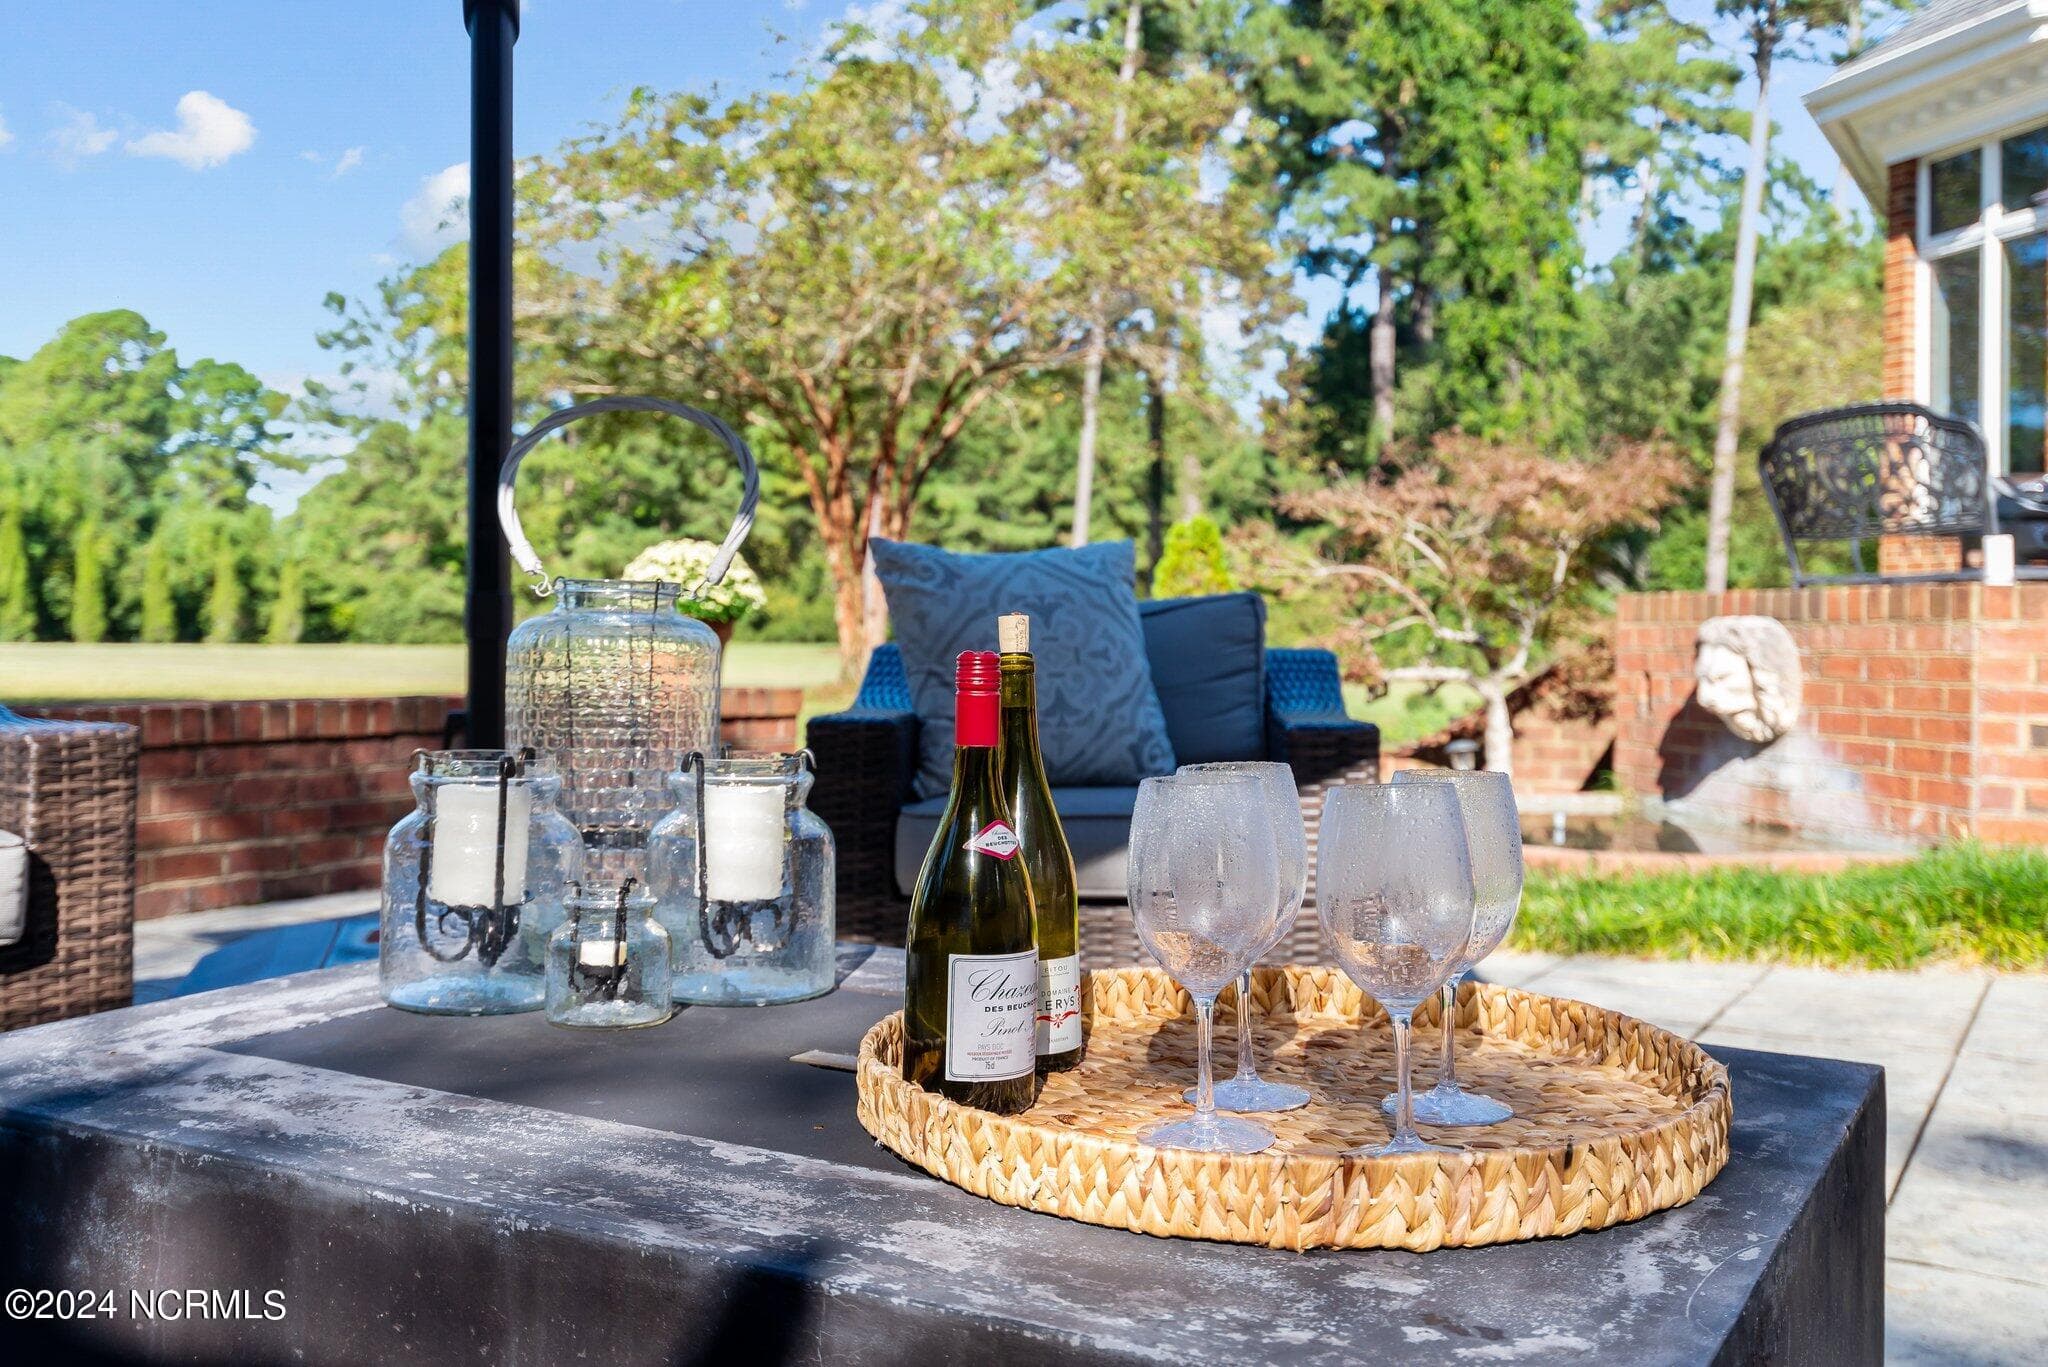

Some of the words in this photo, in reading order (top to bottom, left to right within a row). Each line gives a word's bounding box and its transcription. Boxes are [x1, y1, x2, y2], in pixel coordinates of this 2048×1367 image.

[1041, 987, 1071, 997] DOMAINE
[984, 1005, 1004, 1013] DES
[980, 1017, 1025, 1038] Pinot
